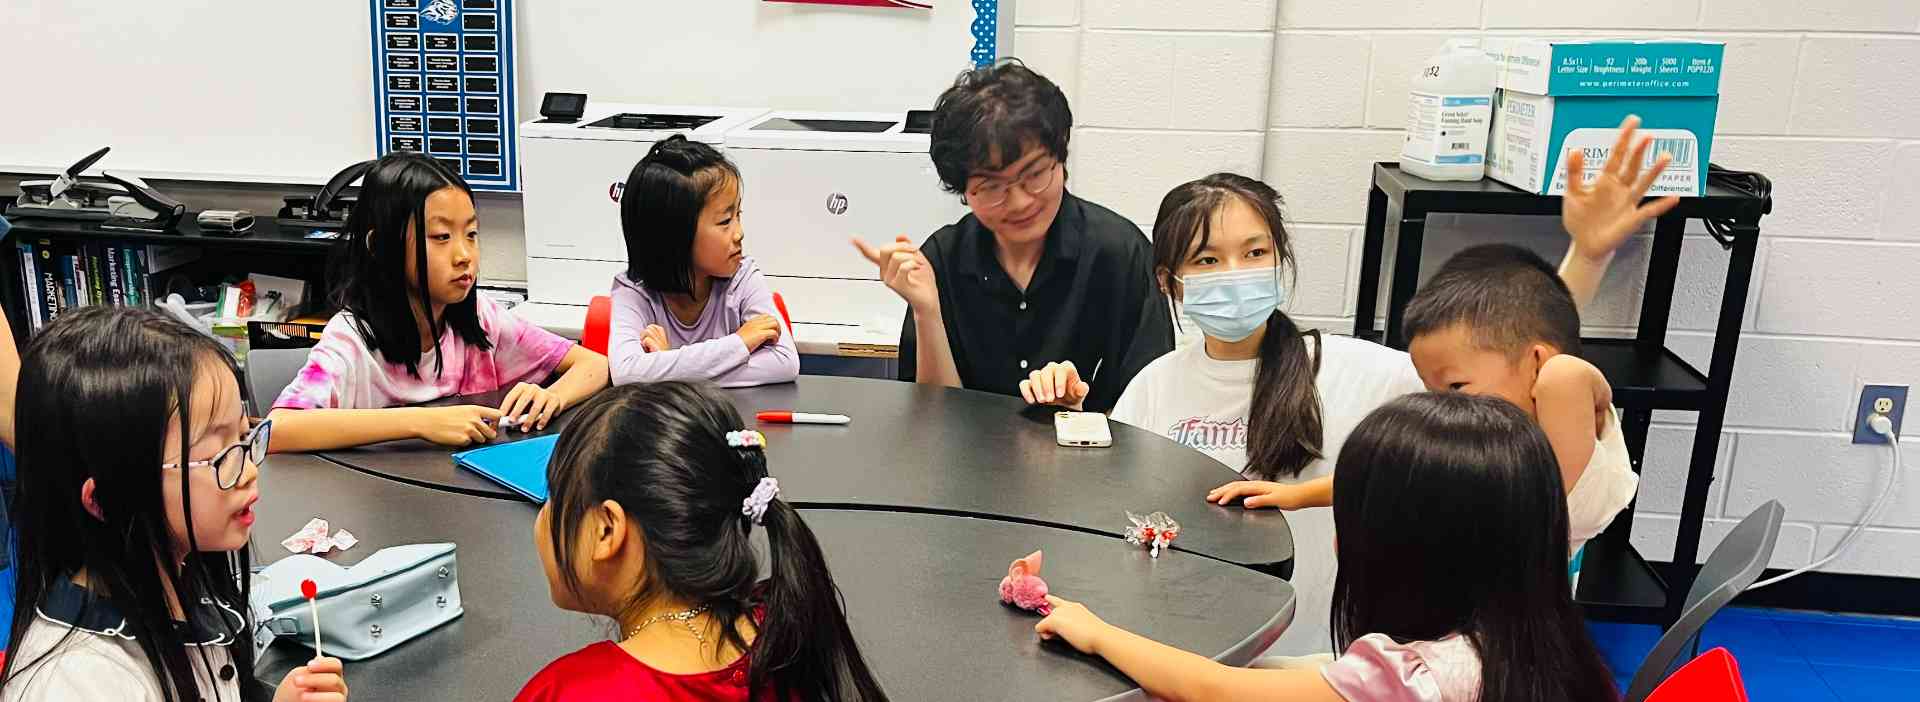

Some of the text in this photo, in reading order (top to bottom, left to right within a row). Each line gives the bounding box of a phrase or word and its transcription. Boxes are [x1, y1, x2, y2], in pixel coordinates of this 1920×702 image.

[1557, 65, 1589, 74] Letter Size
[1593, 65, 1625, 75] Brightness
[829, 193, 846, 214] hp
